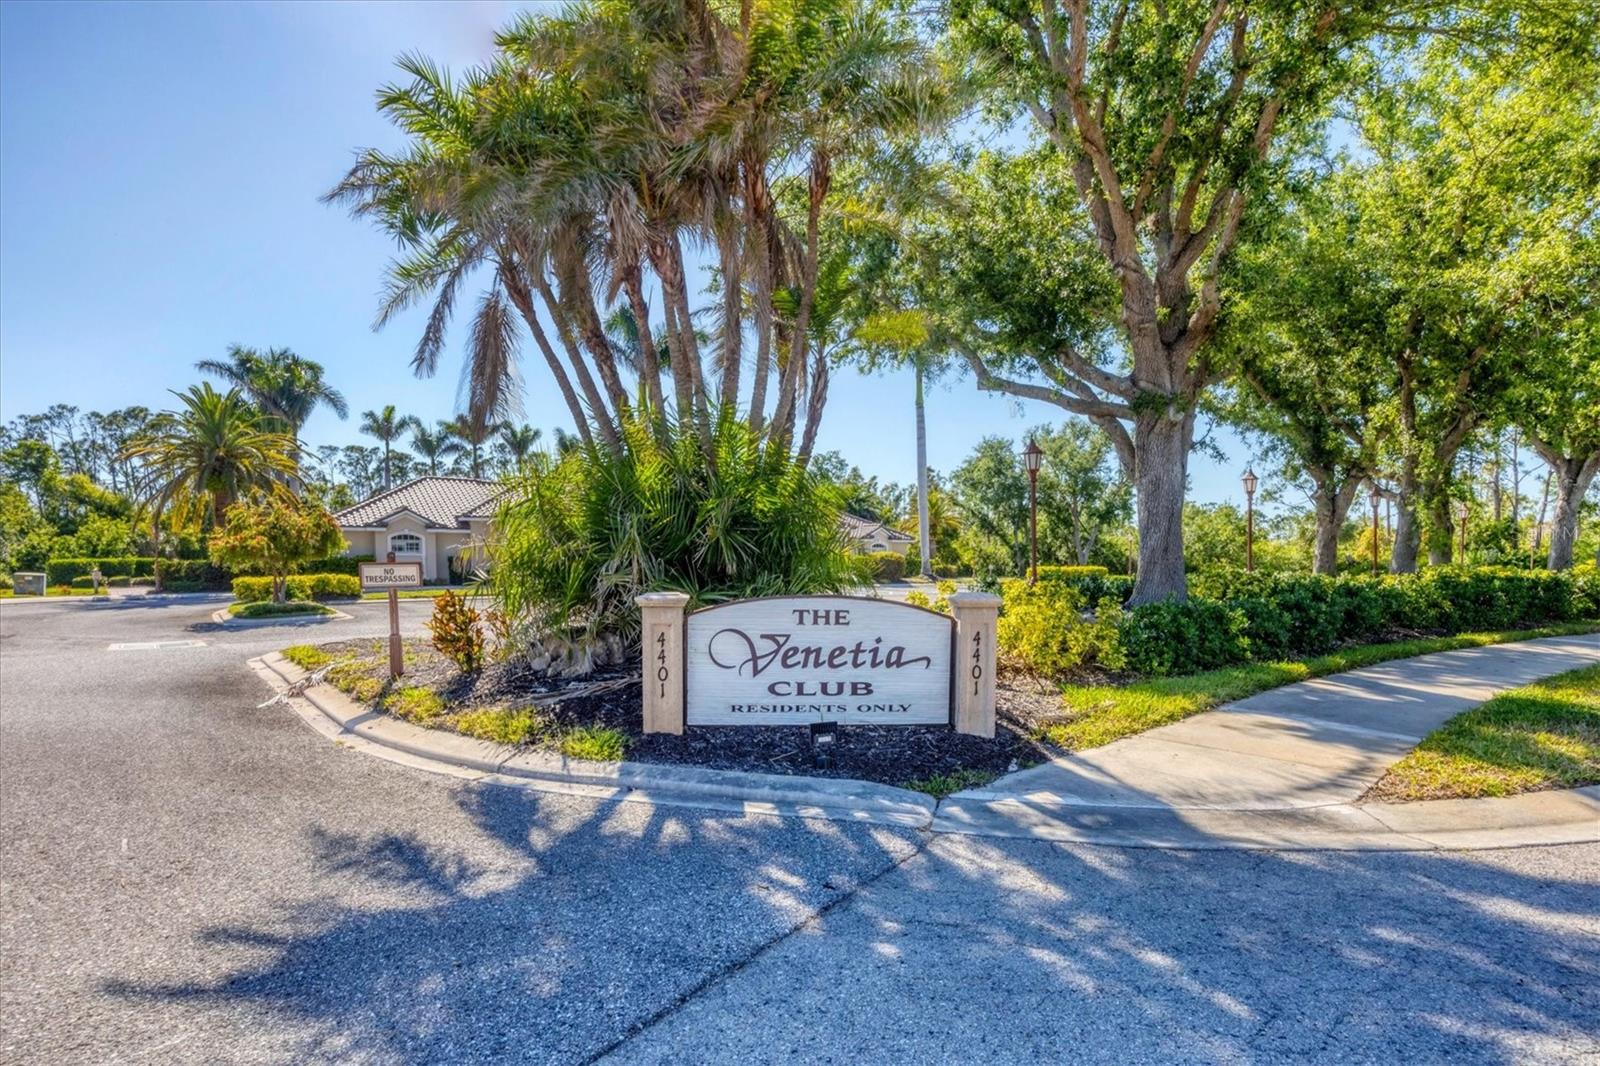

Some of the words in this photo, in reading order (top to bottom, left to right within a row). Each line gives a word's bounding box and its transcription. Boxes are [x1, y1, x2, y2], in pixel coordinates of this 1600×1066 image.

[365, 575, 416, 583] TRESPASSING
[383, 567, 395, 575] NO
[792, 609, 850, 626] THE
[708, 628, 931, 678] Venetia
[657, 631, 669, 699] 4401
[972, 630, 982, 696] 4401
[767, 681, 874, 697] CLUB
[730, 704, 847, 713] RESIDENTS
[857, 704, 912, 713] ONLY
